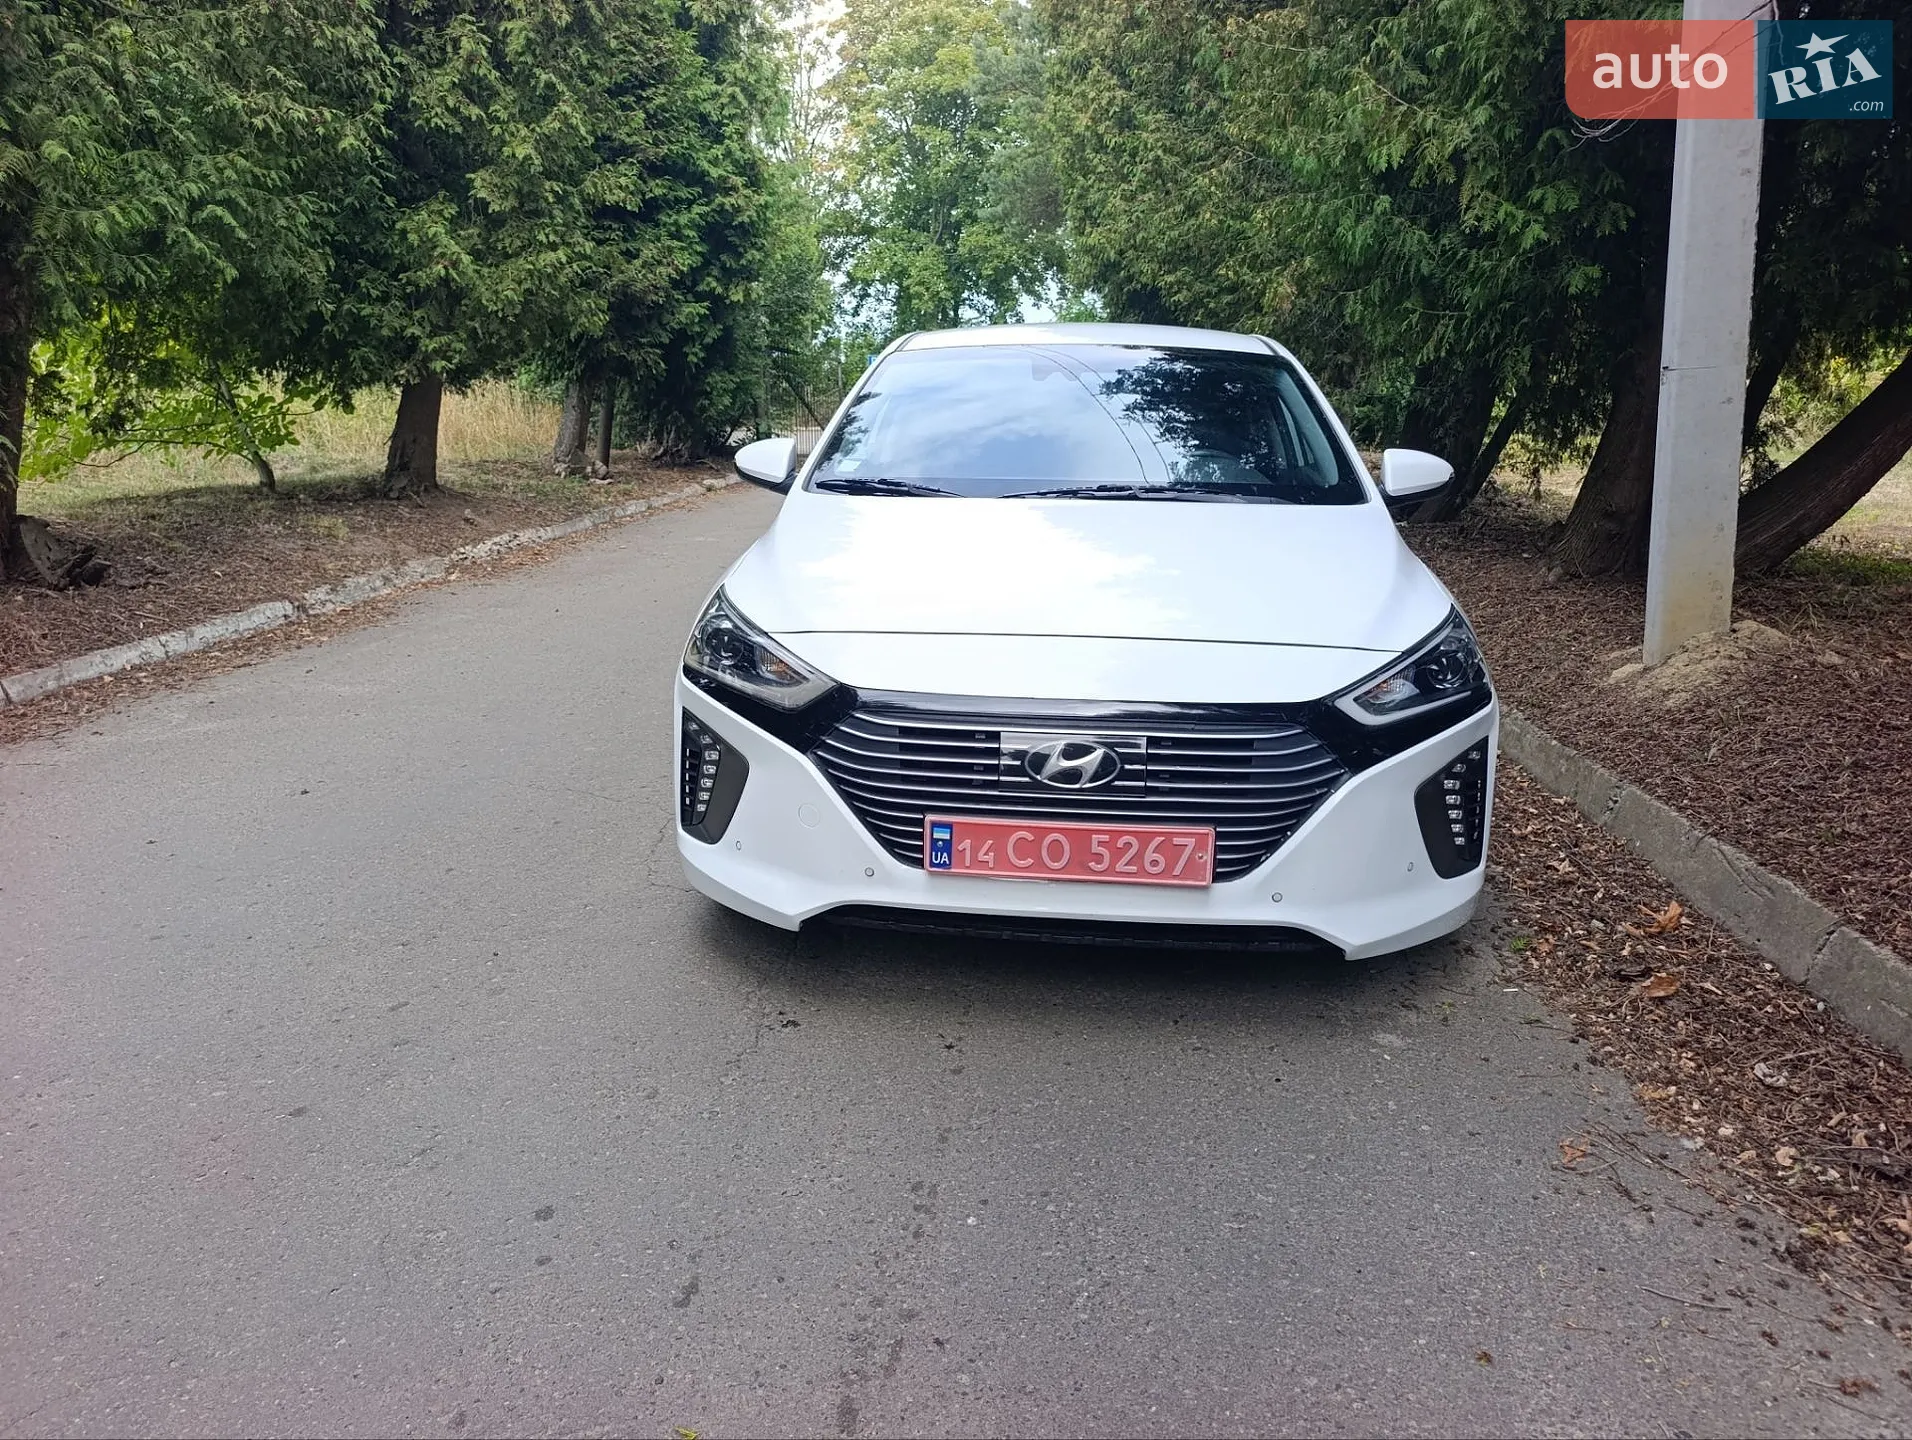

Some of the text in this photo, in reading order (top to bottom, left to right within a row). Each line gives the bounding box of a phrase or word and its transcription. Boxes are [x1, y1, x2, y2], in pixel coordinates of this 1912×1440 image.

[932, 851, 950, 865] UA
[957, 831, 1196, 876] 14 CO 5267
